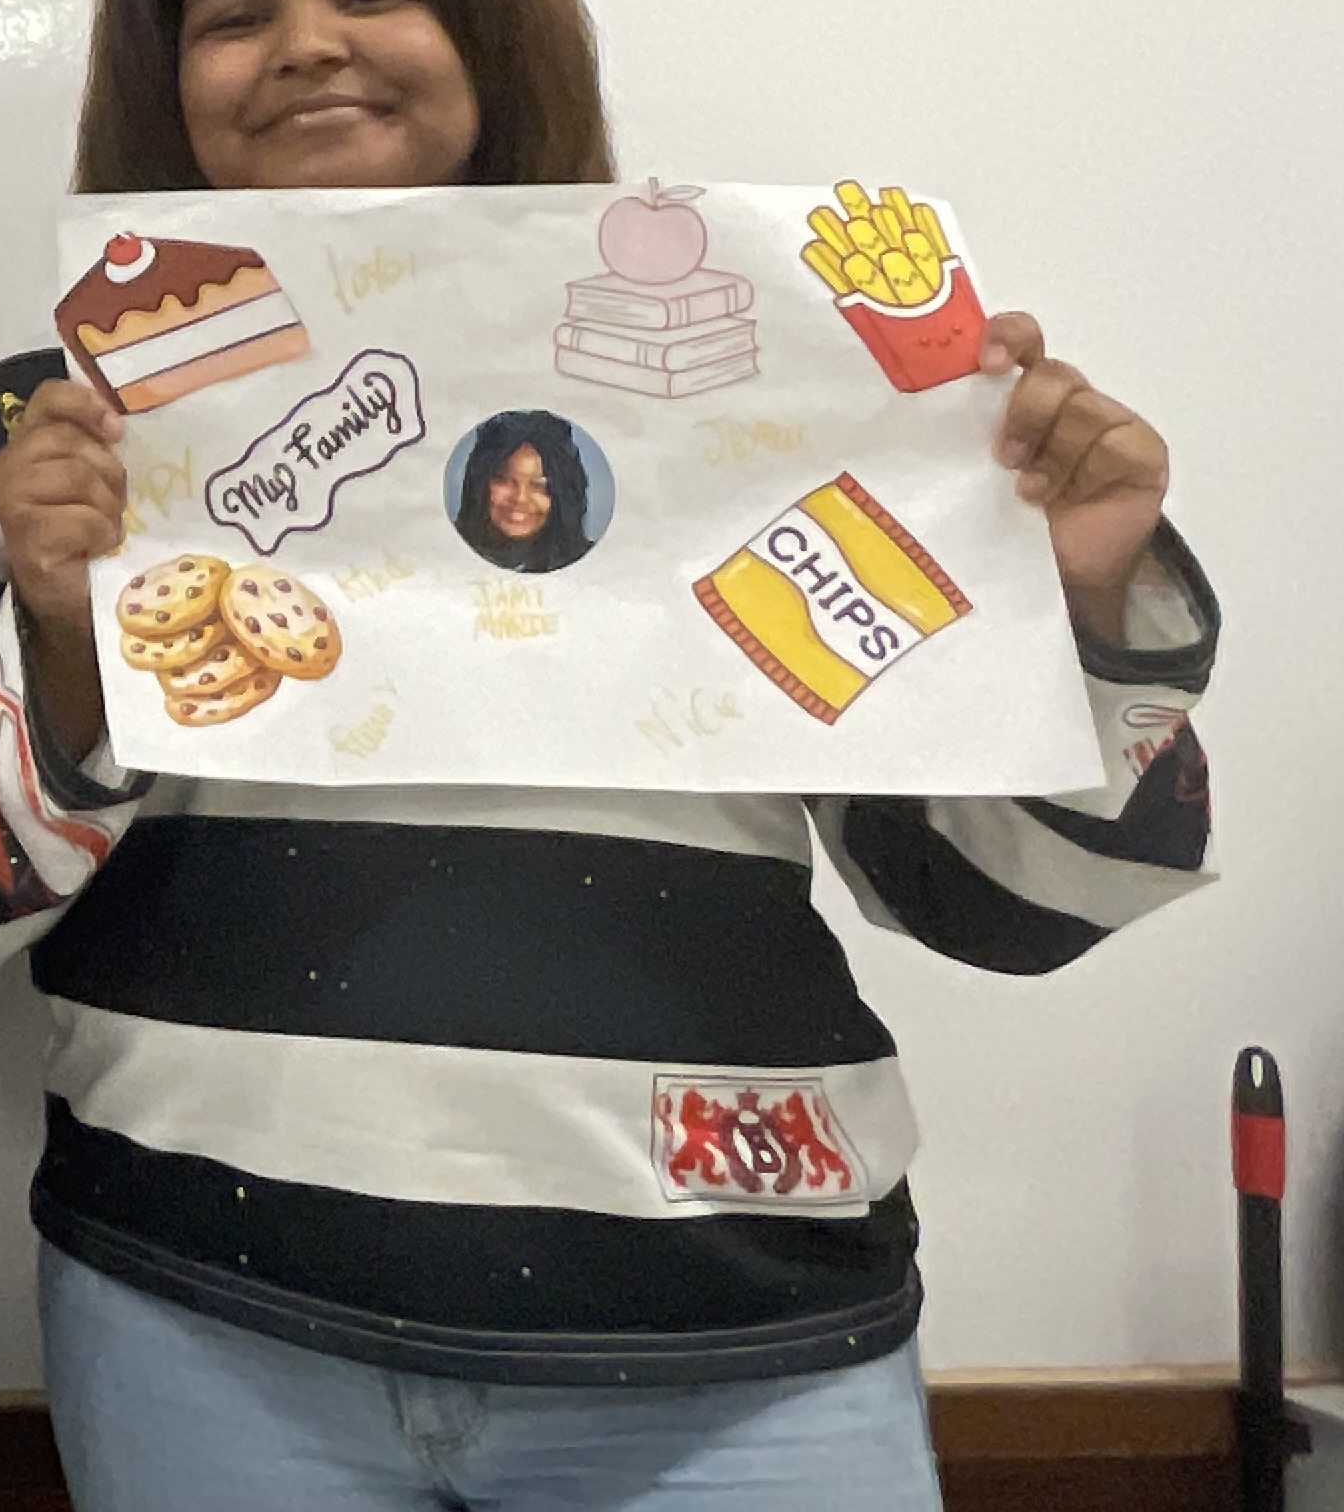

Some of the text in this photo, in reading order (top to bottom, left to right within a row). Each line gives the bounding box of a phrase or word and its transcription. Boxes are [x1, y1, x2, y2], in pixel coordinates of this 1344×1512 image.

[222, 462, 298, 520] My
[282, 370, 402, 470] Family
[766, 524, 900, 664] CHIPS
